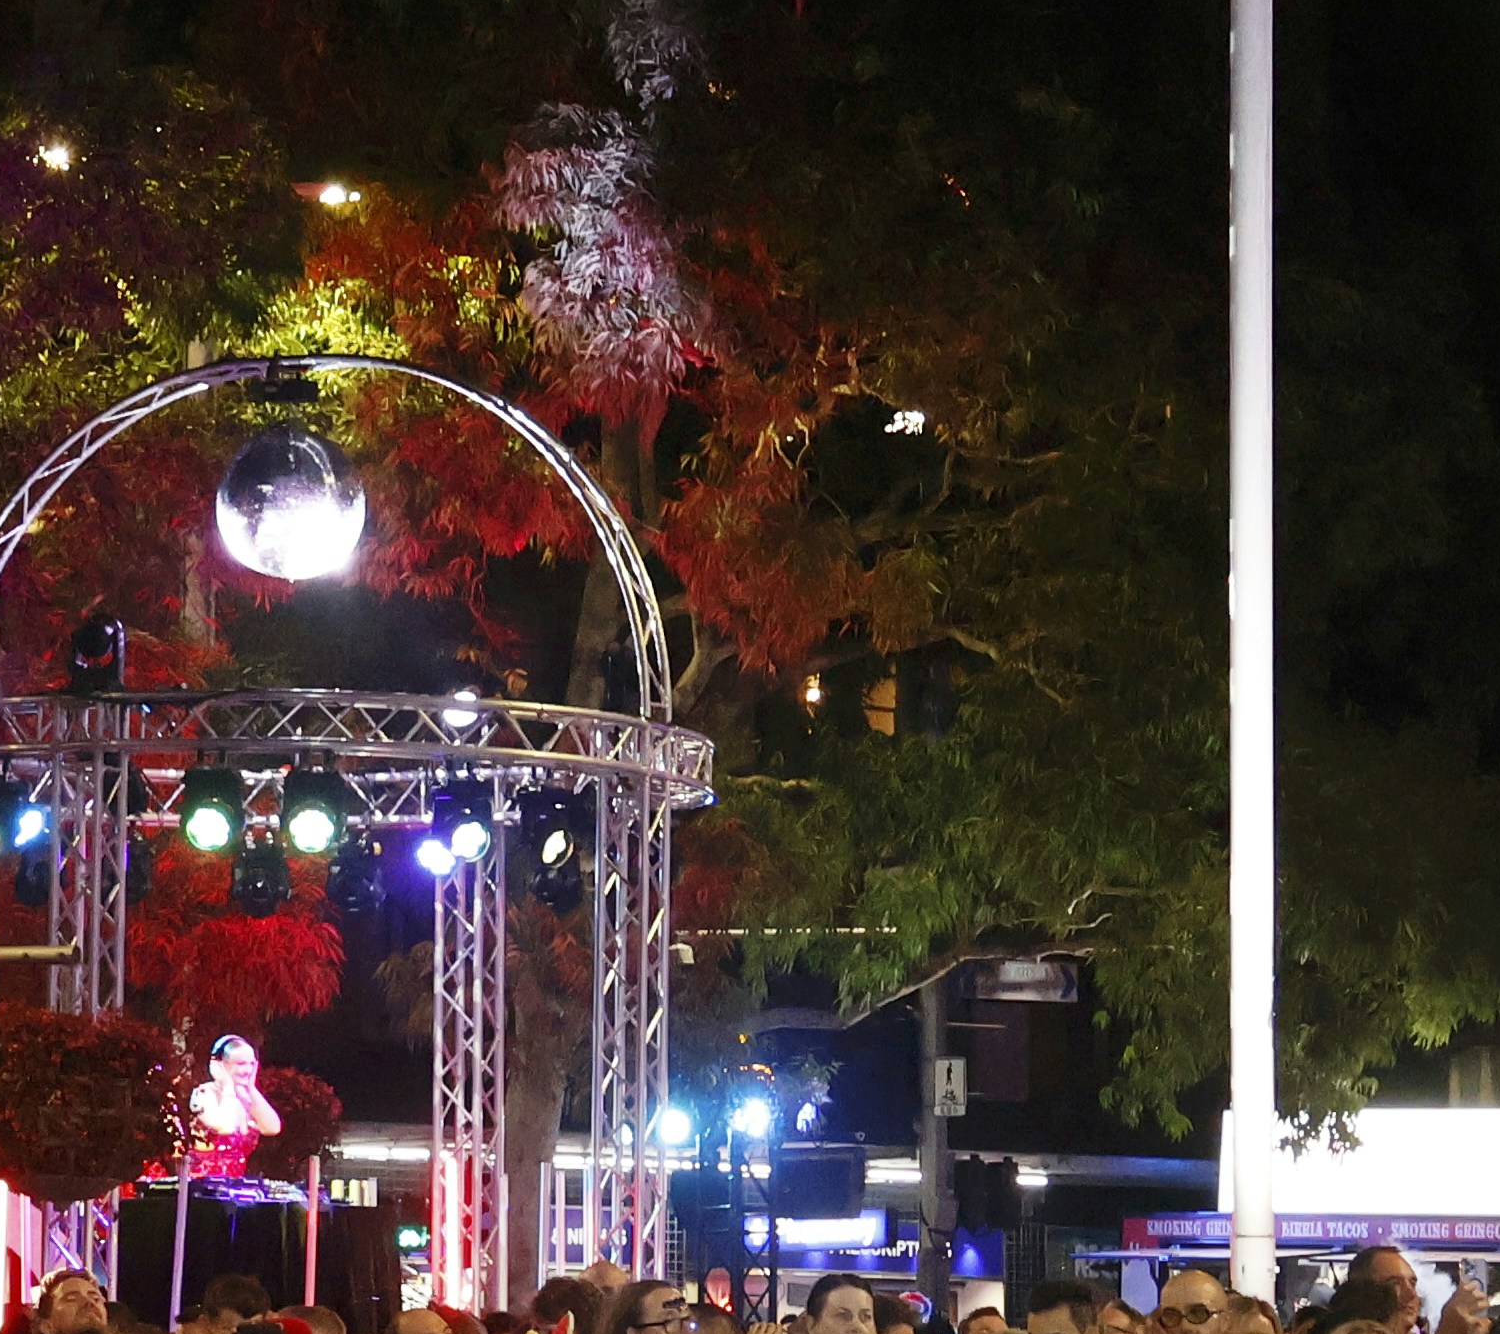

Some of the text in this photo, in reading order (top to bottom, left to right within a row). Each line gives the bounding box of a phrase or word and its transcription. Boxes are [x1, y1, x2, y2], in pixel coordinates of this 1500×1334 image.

[1146, 1220, 1202, 1236] SMOKING
[1326, 1222, 1370, 1238] TACOS
[1390, 1222, 1450, 1239] SMOKING
